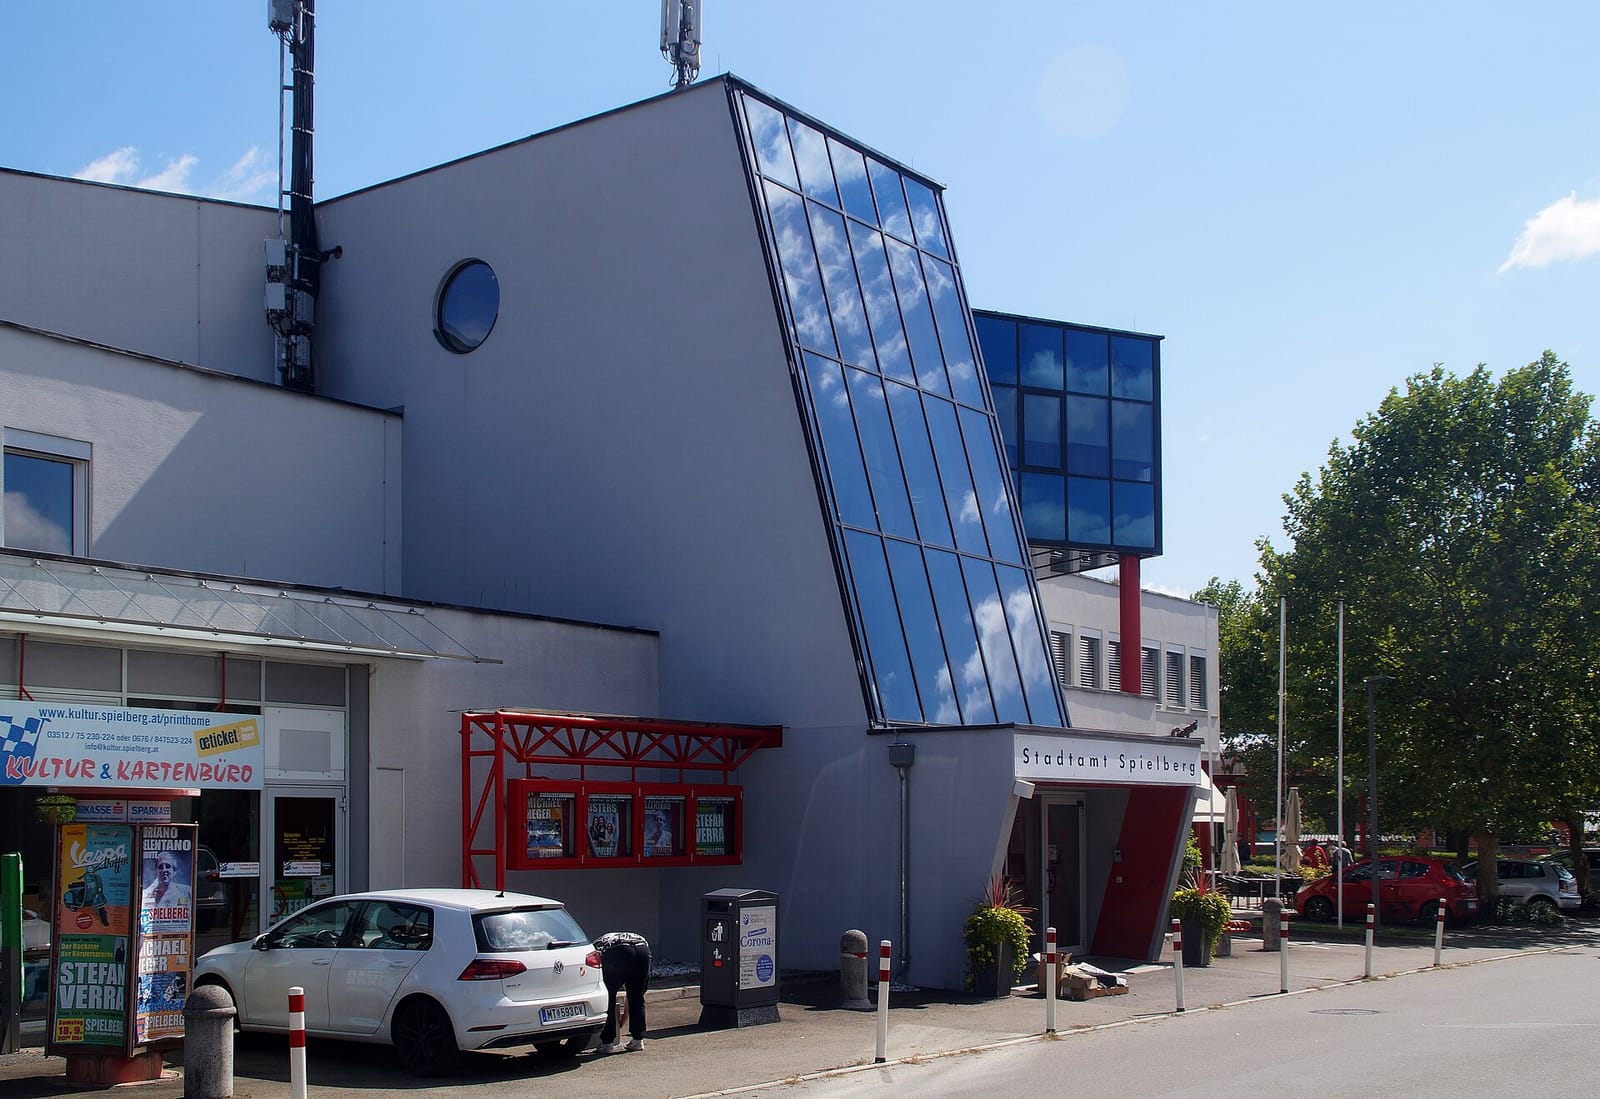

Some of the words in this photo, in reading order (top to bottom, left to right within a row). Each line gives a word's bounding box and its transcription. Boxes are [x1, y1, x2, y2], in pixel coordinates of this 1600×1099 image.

[38, 708, 211, 727] www.kultur.spielberg.at/printhome
[84, 743, 159, 754] info@kultur.spielberg.at
[116, 735, 132, 743] oder
[6, 755, 96, 779] KULTUR
[100, 763, 113, 780] &
[116, 758, 253, 783] KARTENBÜRO
[1022, 747, 1107, 769] Stadtamt
[1119, 753, 1196, 777] Spielberg
[60, 962, 125, 986] STEFAN
[59, 985, 124, 1011] VERRA
